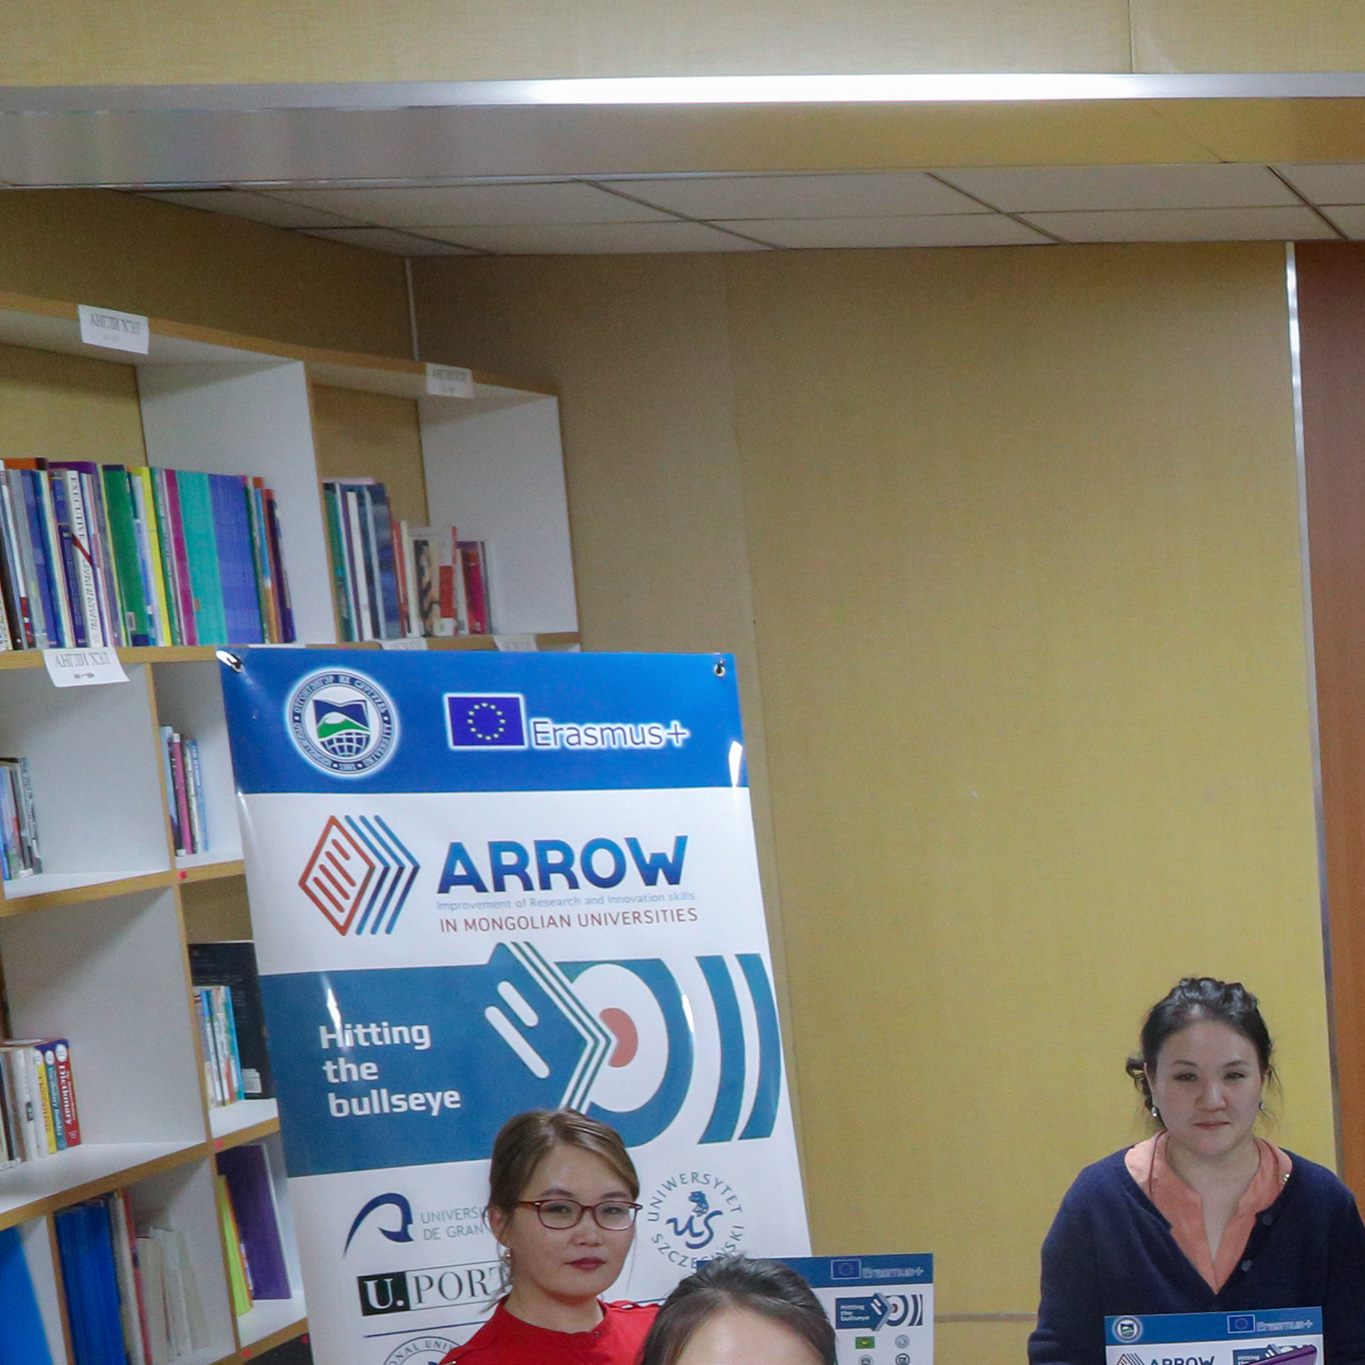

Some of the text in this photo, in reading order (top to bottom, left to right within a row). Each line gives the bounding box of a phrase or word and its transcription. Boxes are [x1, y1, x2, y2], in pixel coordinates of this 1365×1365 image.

[532, 720, 689, 748] Erasmus+
[437, 836, 688, 894] ARROW
[437, 900, 511, 911] Improvement
[515, 898, 526, 908] of
[530, 896, 581, 907] Research
[585, 895, 604, 905] and
[607, 893, 665, 904] Innovation
[440, 908, 698, 932] IN MONGOLIAN UNIVERSITIES
[319, 1024, 431, 1050] Hitting
[323, 1059, 379, 1083] the
[329, 1088, 461, 1118] bullseye
[648, 1172, 743, 1222] UNIWERSYTET
[420, 1207, 488, 1223] UNIVERSI
[424, 1229, 441, 1240] DE
